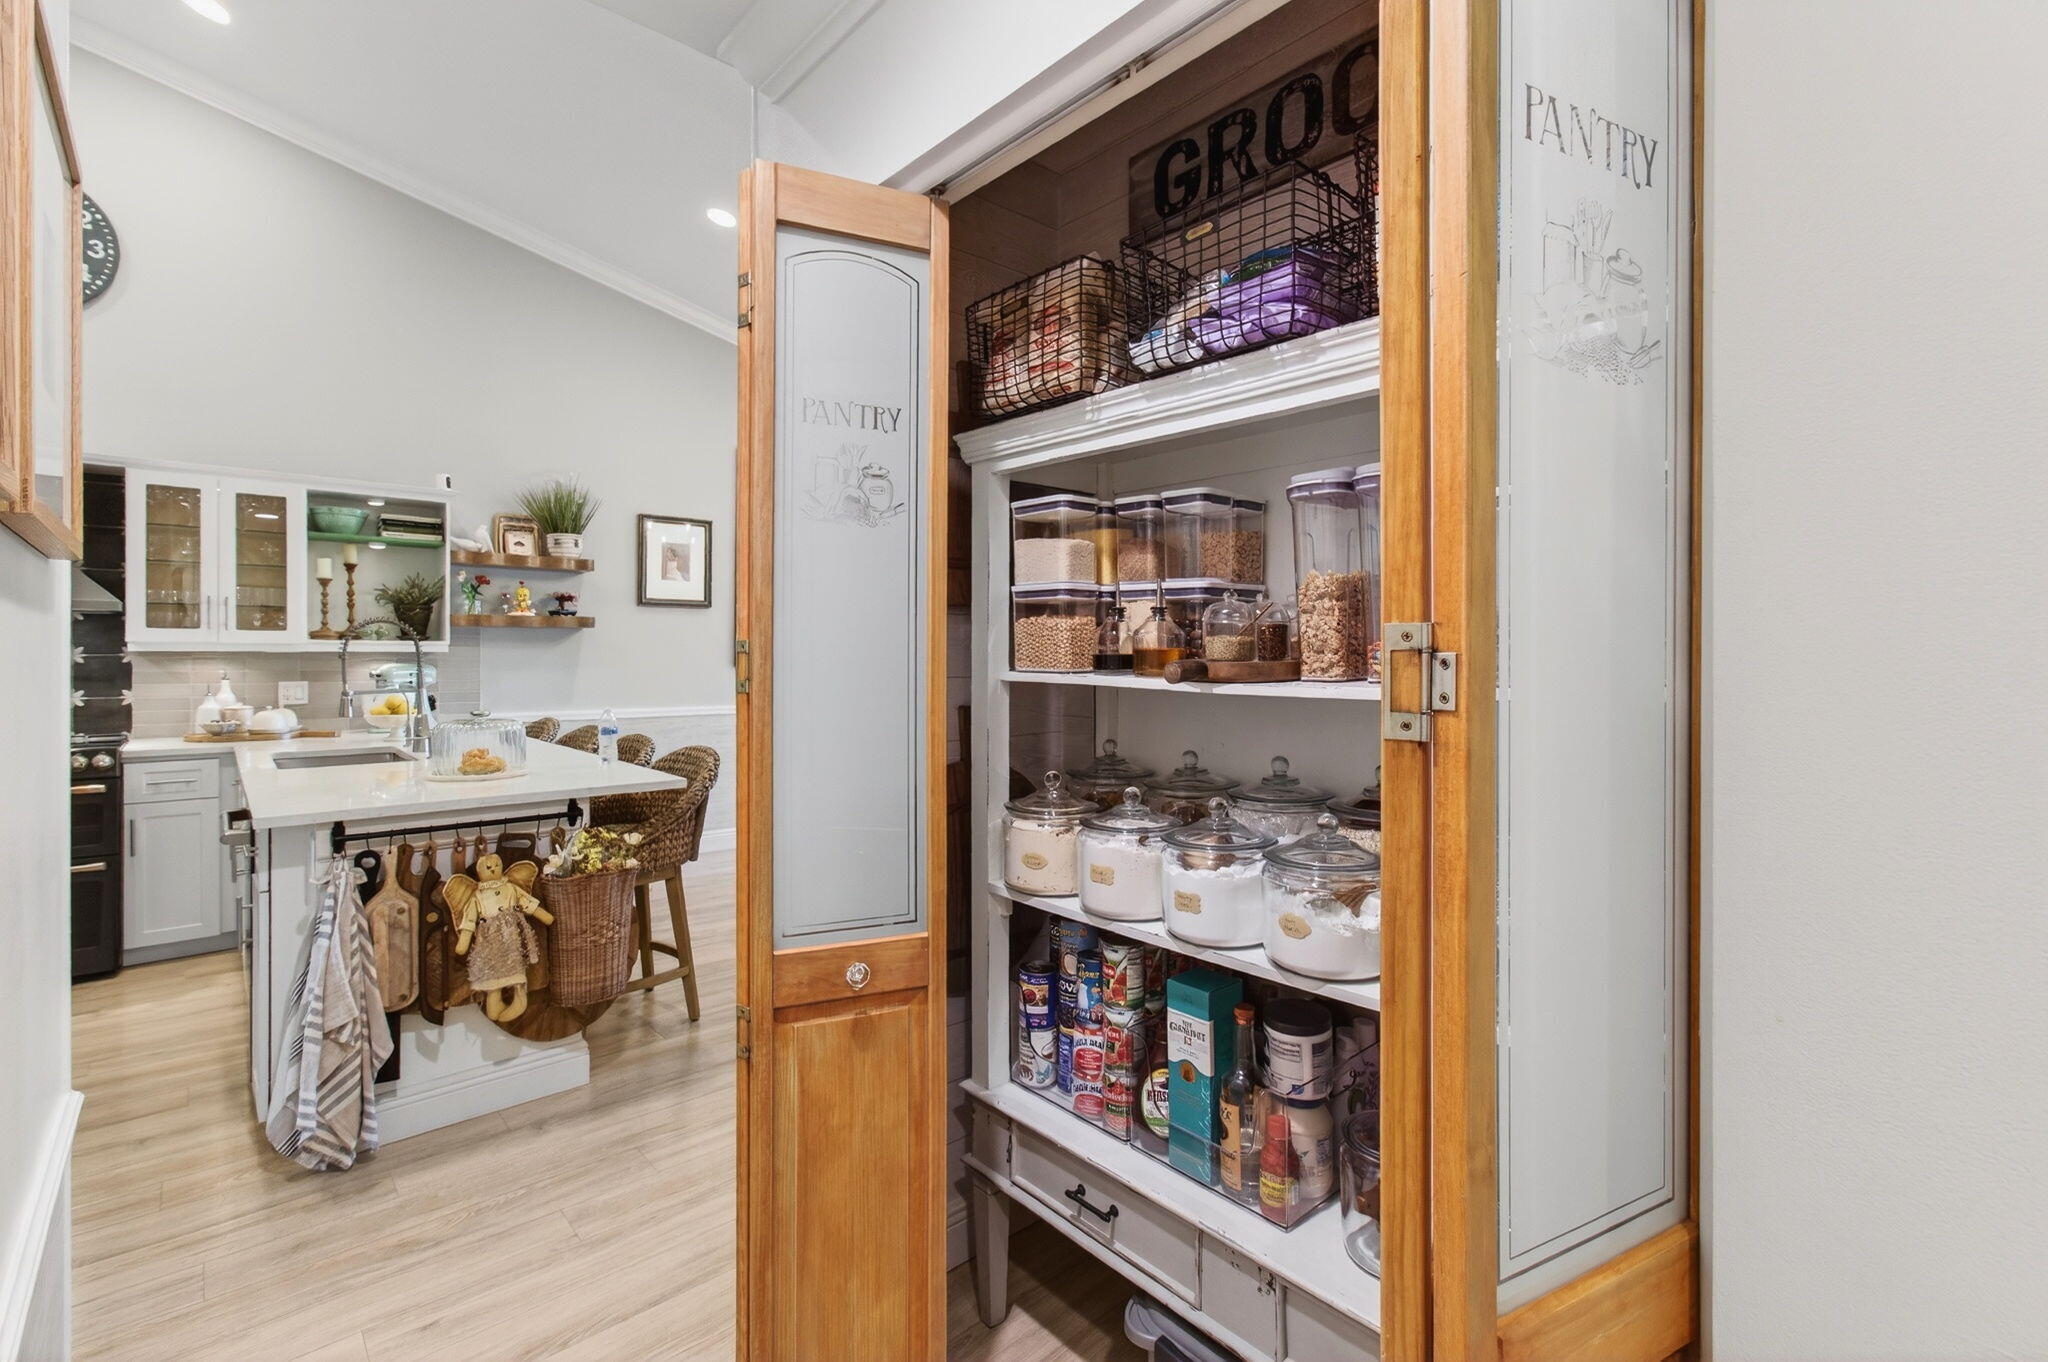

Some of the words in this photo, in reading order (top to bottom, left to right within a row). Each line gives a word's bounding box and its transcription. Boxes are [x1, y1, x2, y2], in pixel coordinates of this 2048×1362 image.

[1525, 82, 1658, 190] PANTRY
[86, 239, 106, 259] 3
[802, 397, 902, 434] PANTRY
